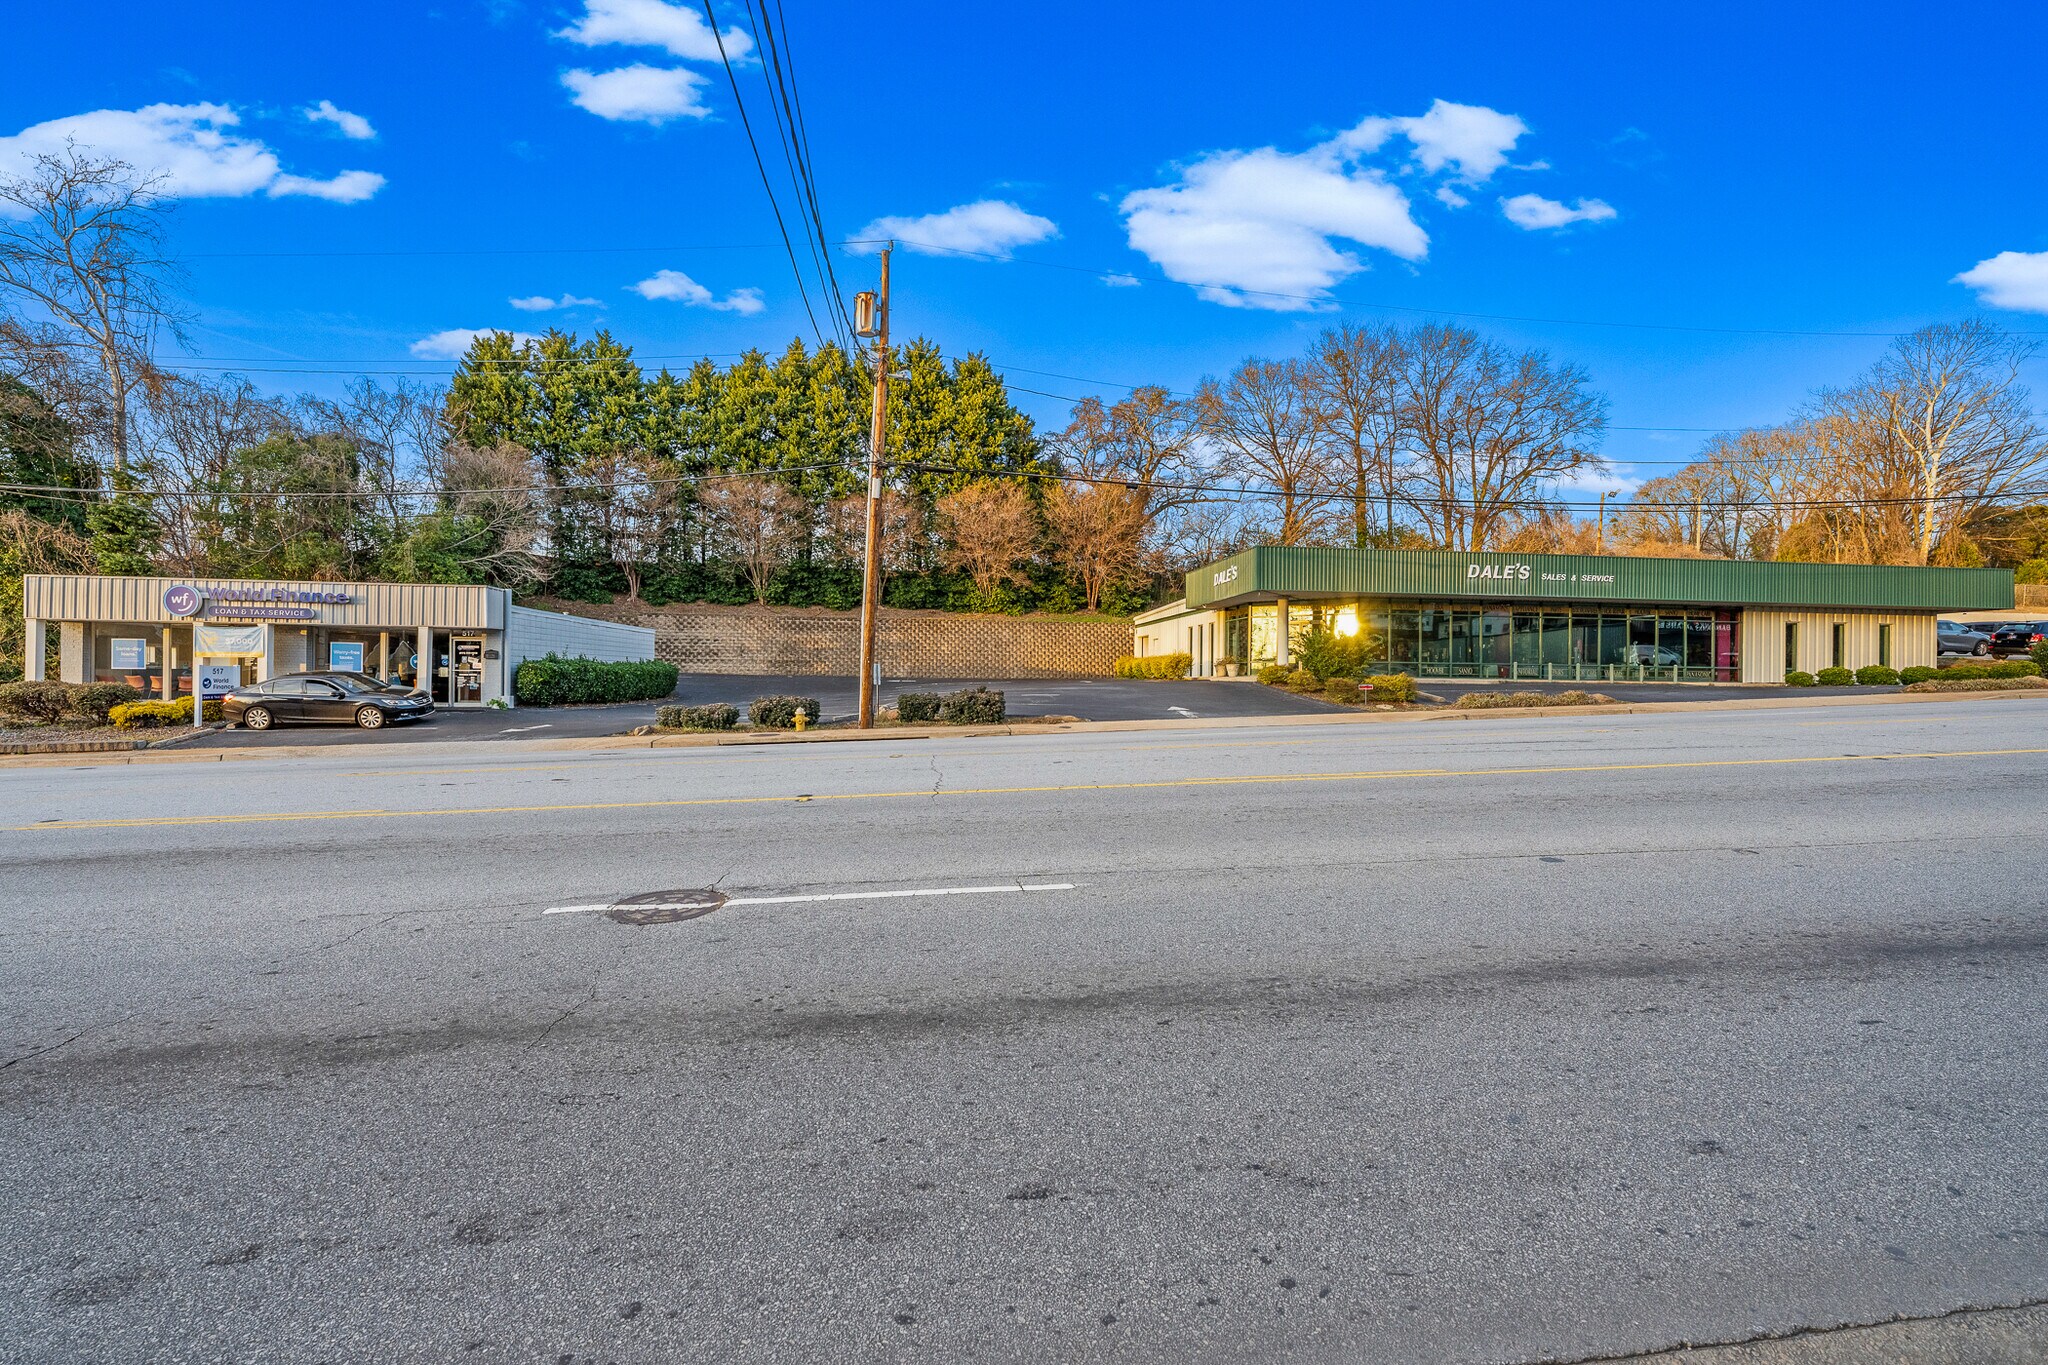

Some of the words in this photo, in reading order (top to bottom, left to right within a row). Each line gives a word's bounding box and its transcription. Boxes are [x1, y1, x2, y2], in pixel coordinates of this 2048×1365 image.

[1213, 565, 1238, 587] DALE'S
[1467, 563, 1531, 580] DALE'S
[1541, 573, 1567, 581] SALES
[1581, 575, 1615, 583] SERVICE
[207, 587, 266, 601] World
[271, 588, 350, 604] Finance
[268, 609, 305, 617] SERVICE
